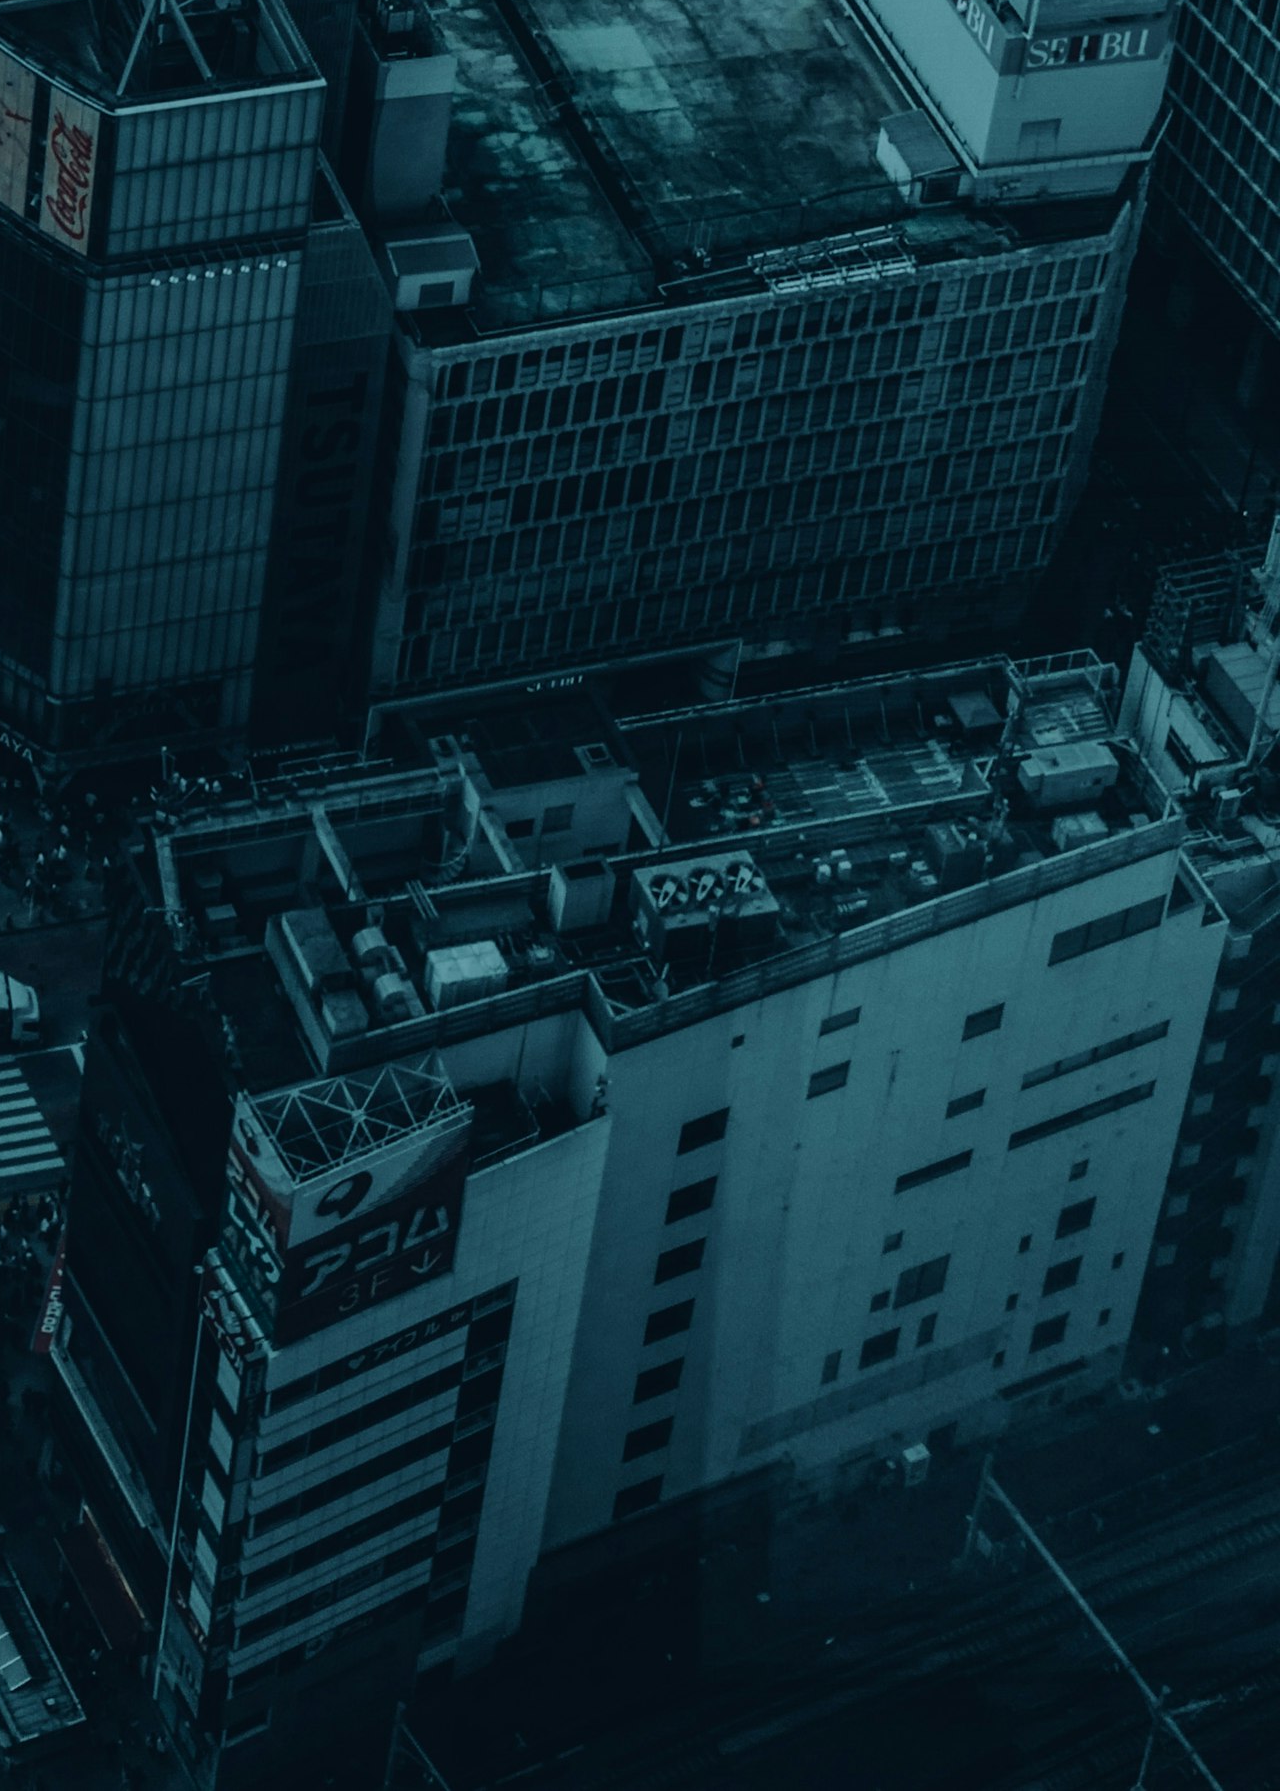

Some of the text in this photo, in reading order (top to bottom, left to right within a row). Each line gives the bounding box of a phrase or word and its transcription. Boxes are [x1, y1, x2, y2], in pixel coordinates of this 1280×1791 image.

[1026, 26, 1149, 71] SEIBU
[276, 371, 369, 678] TSUTAYA
[227, 1190, 280, 1285] レイク
[302, 1206, 451, 1296] アコム
[338, 1272, 392, 1315] 3F
[376, 1320, 444, 1363] アイフル
